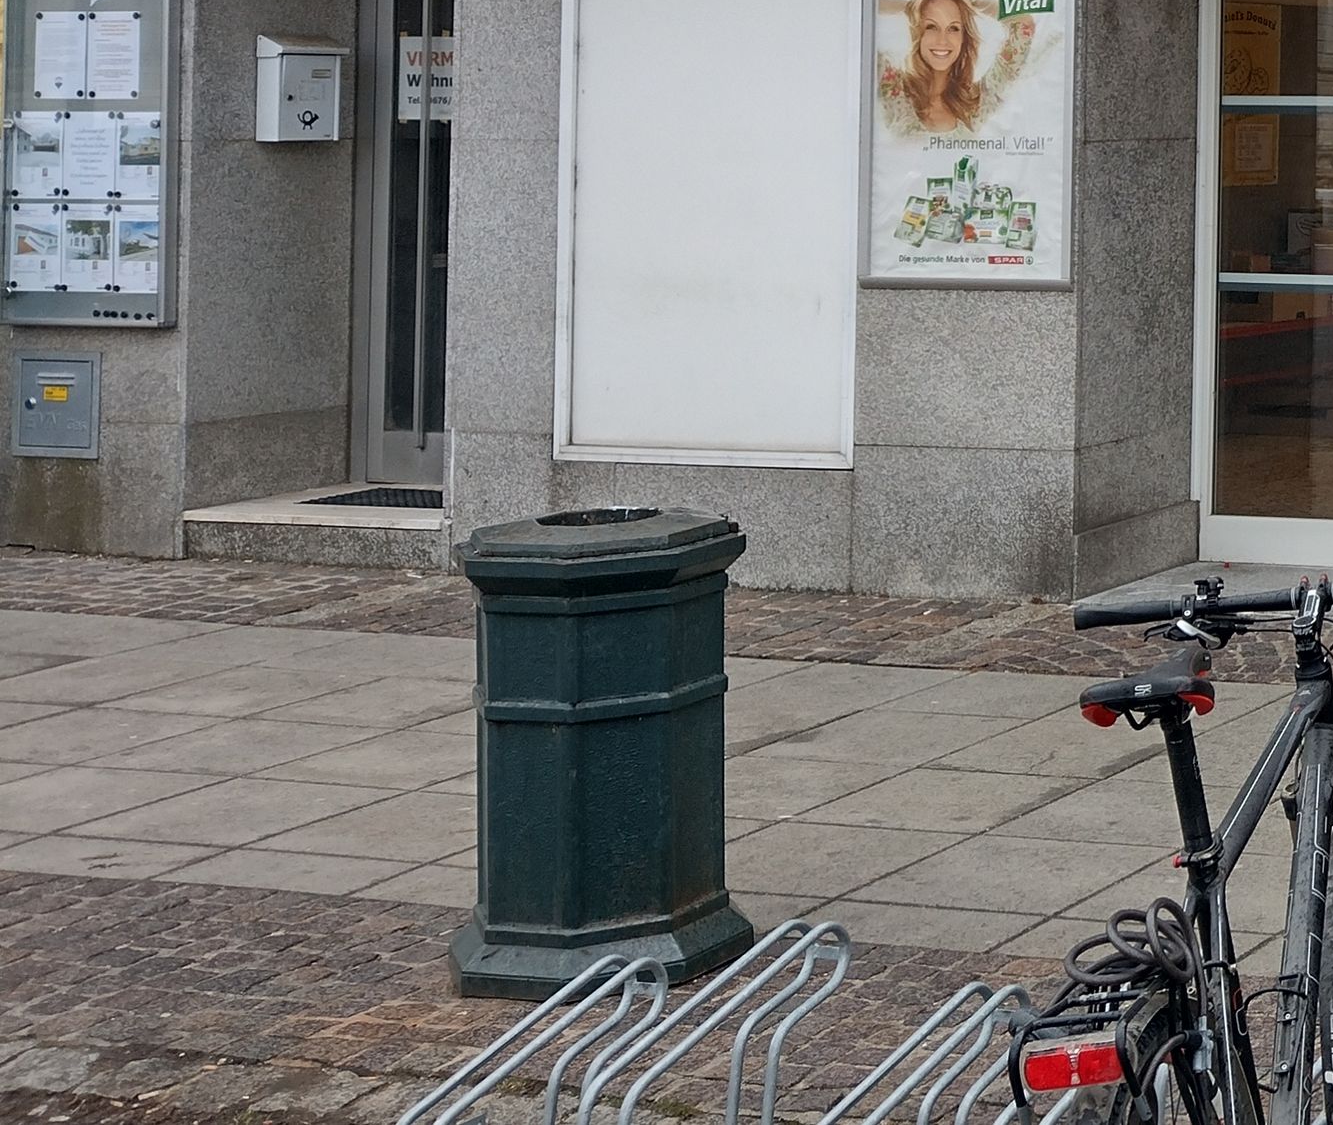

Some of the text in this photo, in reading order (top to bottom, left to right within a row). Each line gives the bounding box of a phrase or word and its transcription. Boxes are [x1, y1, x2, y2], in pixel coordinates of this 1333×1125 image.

[407, 73, 453, 88] Whn
[898, 255, 911, 263] Die
[913, 256, 944, 264] gesunde
[946, 255, 969, 263] Marke
[993, 256, 1024, 264] SPAR
